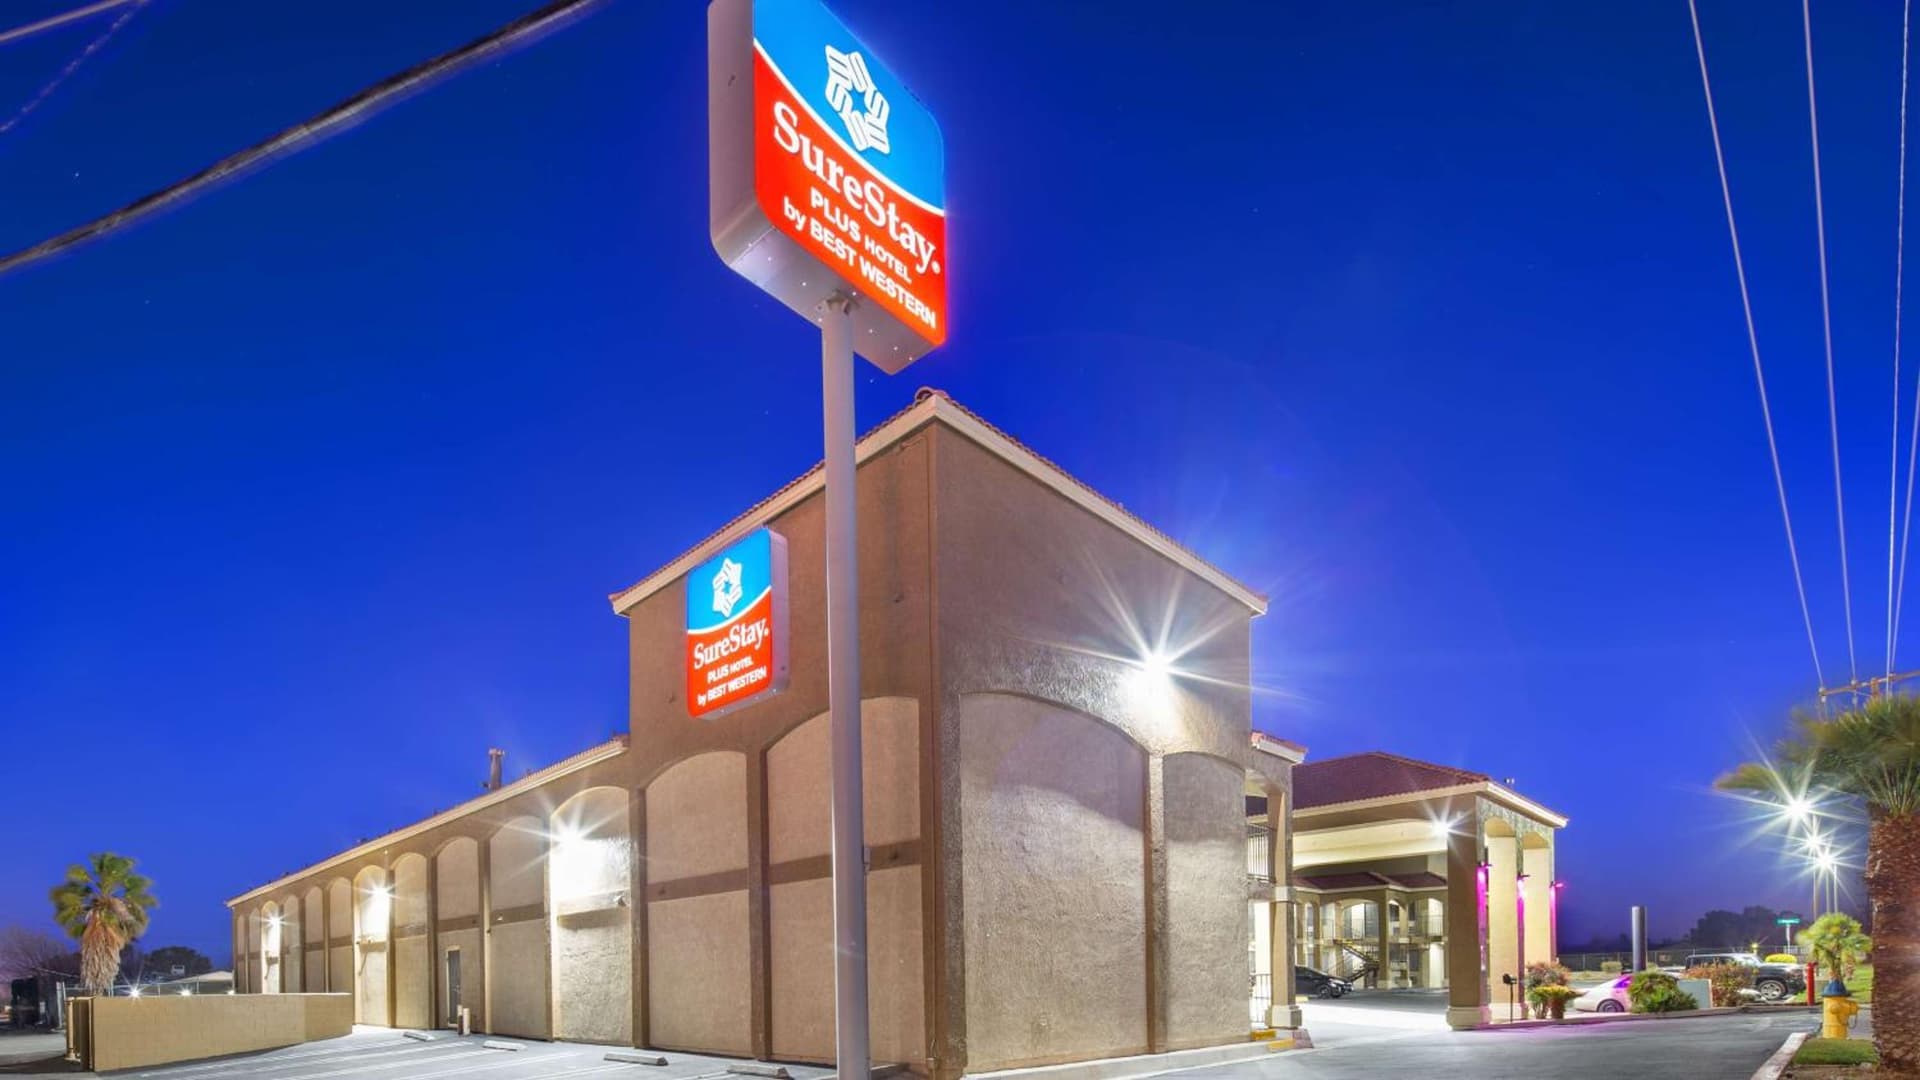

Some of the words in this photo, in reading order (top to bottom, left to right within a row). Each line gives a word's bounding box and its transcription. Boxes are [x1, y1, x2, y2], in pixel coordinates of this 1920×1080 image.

[783, 196, 806, 232] by
[810, 221, 856, 267] BEST
[859, 256, 937, 329] WESTERN
[810, 187, 861, 242] PLUS
[865, 234, 912, 283] HOTEL
[697, 694, 707, 706] by
[708, 682, 727, 702] BEST
[728, 665, 767, 692] WESTERN
[707, 664, 729, 683] PLUS
[730, 656, 754, 673] HOTEL
